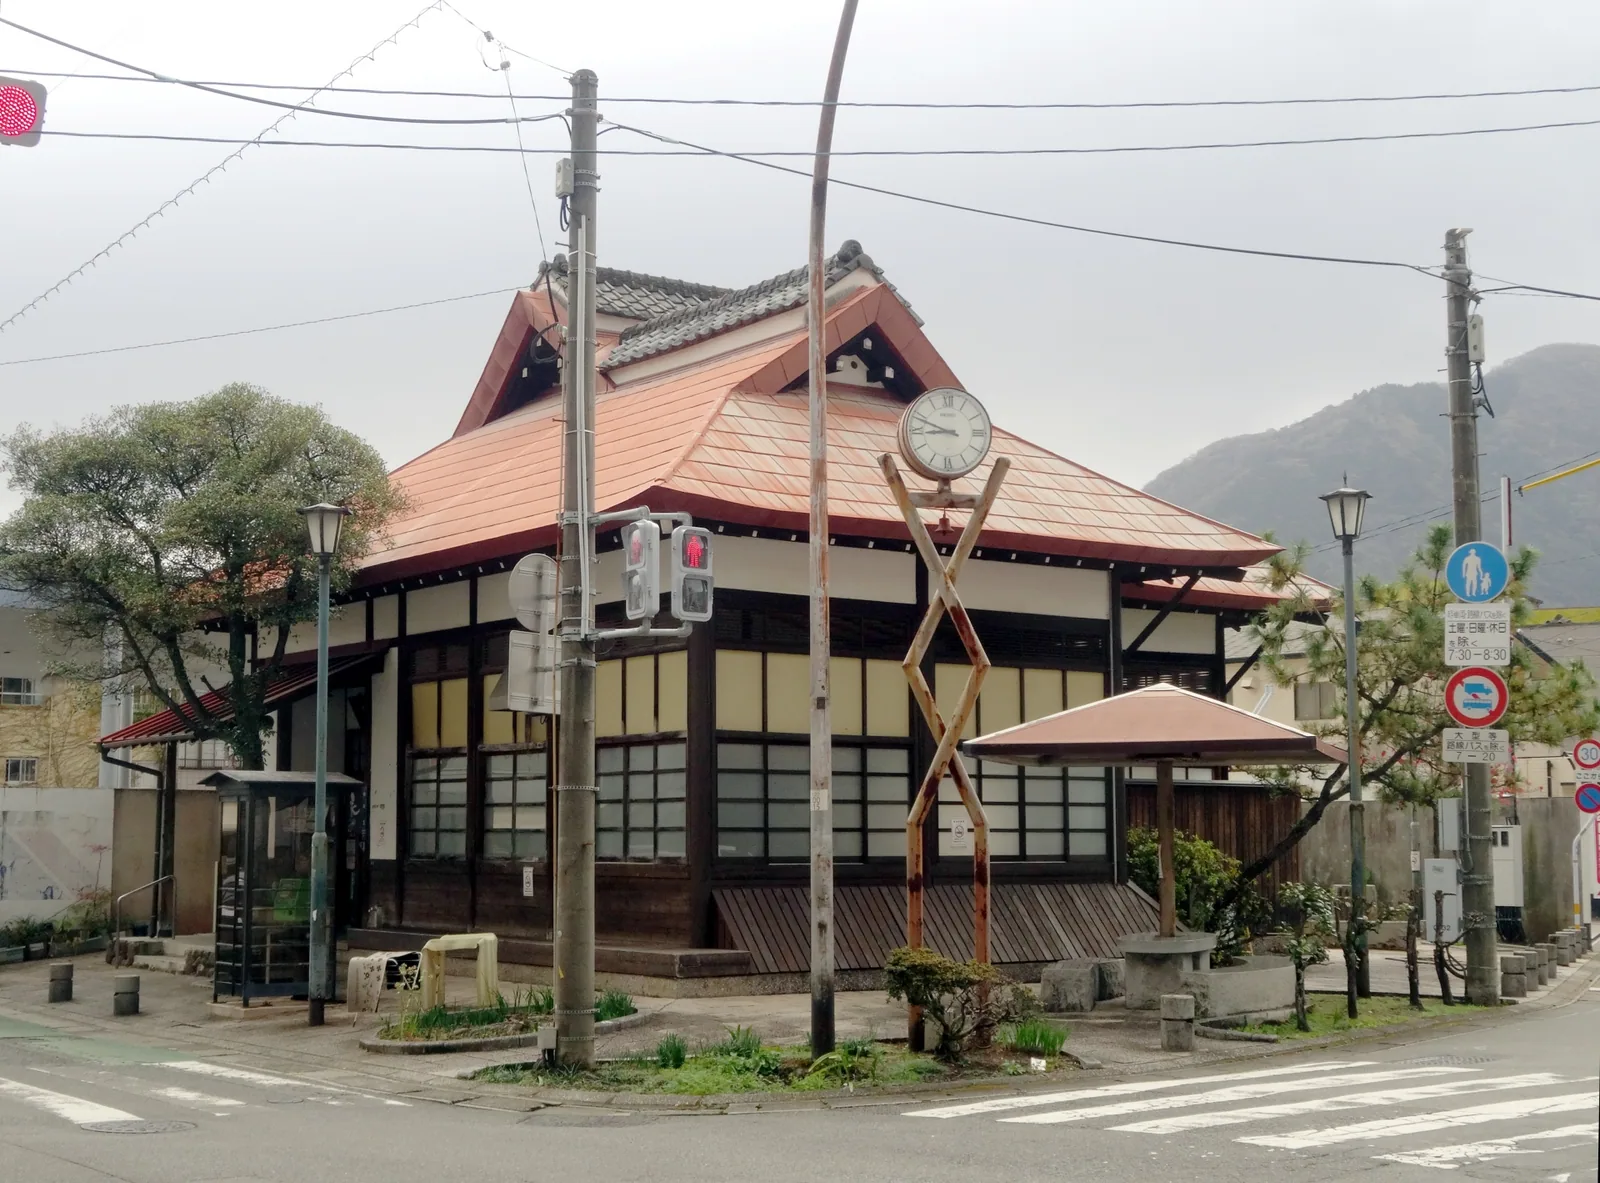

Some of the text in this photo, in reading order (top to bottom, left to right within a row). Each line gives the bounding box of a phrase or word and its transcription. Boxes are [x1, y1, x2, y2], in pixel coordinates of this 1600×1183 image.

[1449, 636, 1478, 647] を除く
[1447, 741, 1505, 751] 路線バスを除く
[1581, 747, 1598, 761] 30
